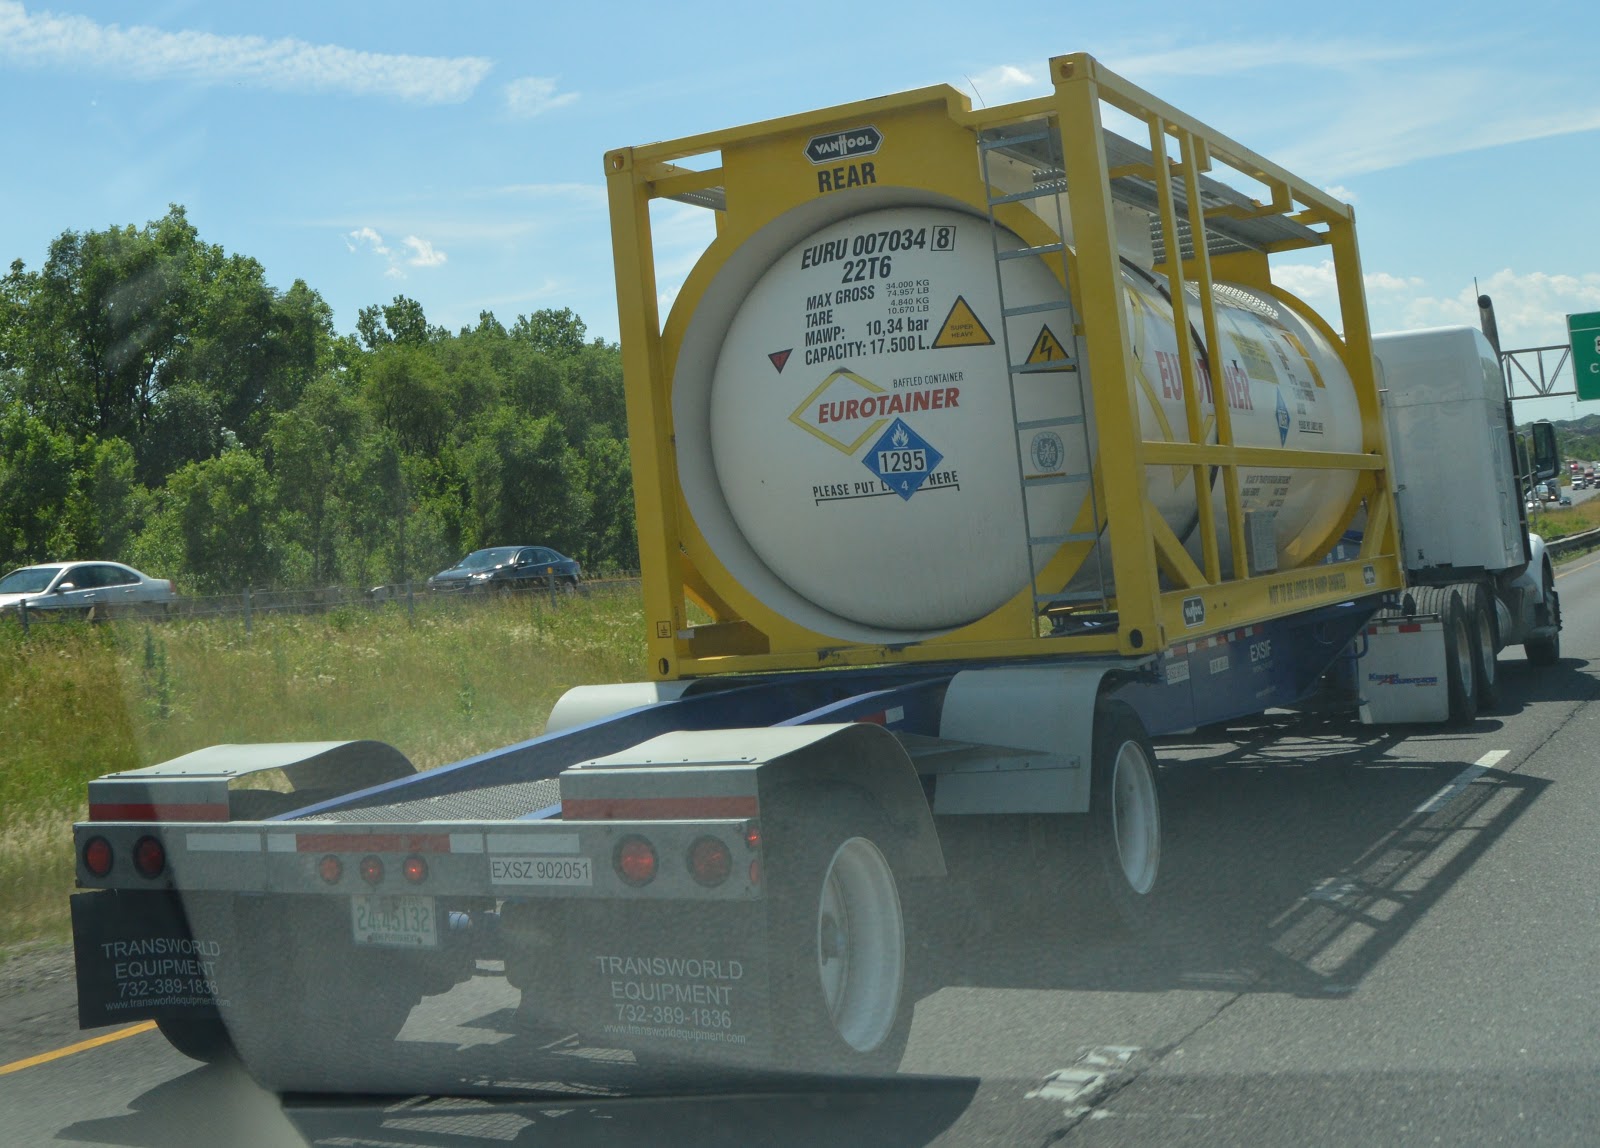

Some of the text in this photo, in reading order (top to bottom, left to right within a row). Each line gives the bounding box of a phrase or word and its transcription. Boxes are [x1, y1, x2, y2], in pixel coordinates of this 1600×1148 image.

[818, 162, 876, 193] REAR
[801, 228, 950, 270] EURU 007034 8
[842, 255, 892, 284] 22T6
[886, 281, 913, 290] 34.000
[887, 288, 914, 297] 74.957
[806, 285, 875, 311] MAX GROSS
[891, 298, 913, 306] 4.840
[806, 310, 833, 329] TARE
[888, 306, 914, 314] 10.670
[805, 317, 929, 347] MAWP: 10,34 bar
[806, 340, 867, 366] CAPACITY:
[870, 336, 917, 355] 17.500
[893, 372, 964, 388] BAFFLED CONTAINER
[819, 388, 960, 424] EUROTAINER
[880, 451, 925, 472] 1295
[813, 484, 850, 497] PLEASE
[855, 481, 875, 494] PUT
[929, 471, 958, 486] HERE
[901, 480, 909, 491] 4
[1250, 640, 1271, 662] EXSIF
[492, 862, 589, 879] EXSZ 902051
[102, 938, 220, 958] TRANSWORLD
[115, 959, 215, 979] EQUIPMENT
[596, 956, 743, 980] TRANSWORLD
[118, 978, 219, 998] 732-389-1836
[611, 981, 732, 1005] EQUIPMENT
[615, 1004, 732, 1028] 732-389-1836
[604, 1023, 745, 1044] www.transworldequipment.com
